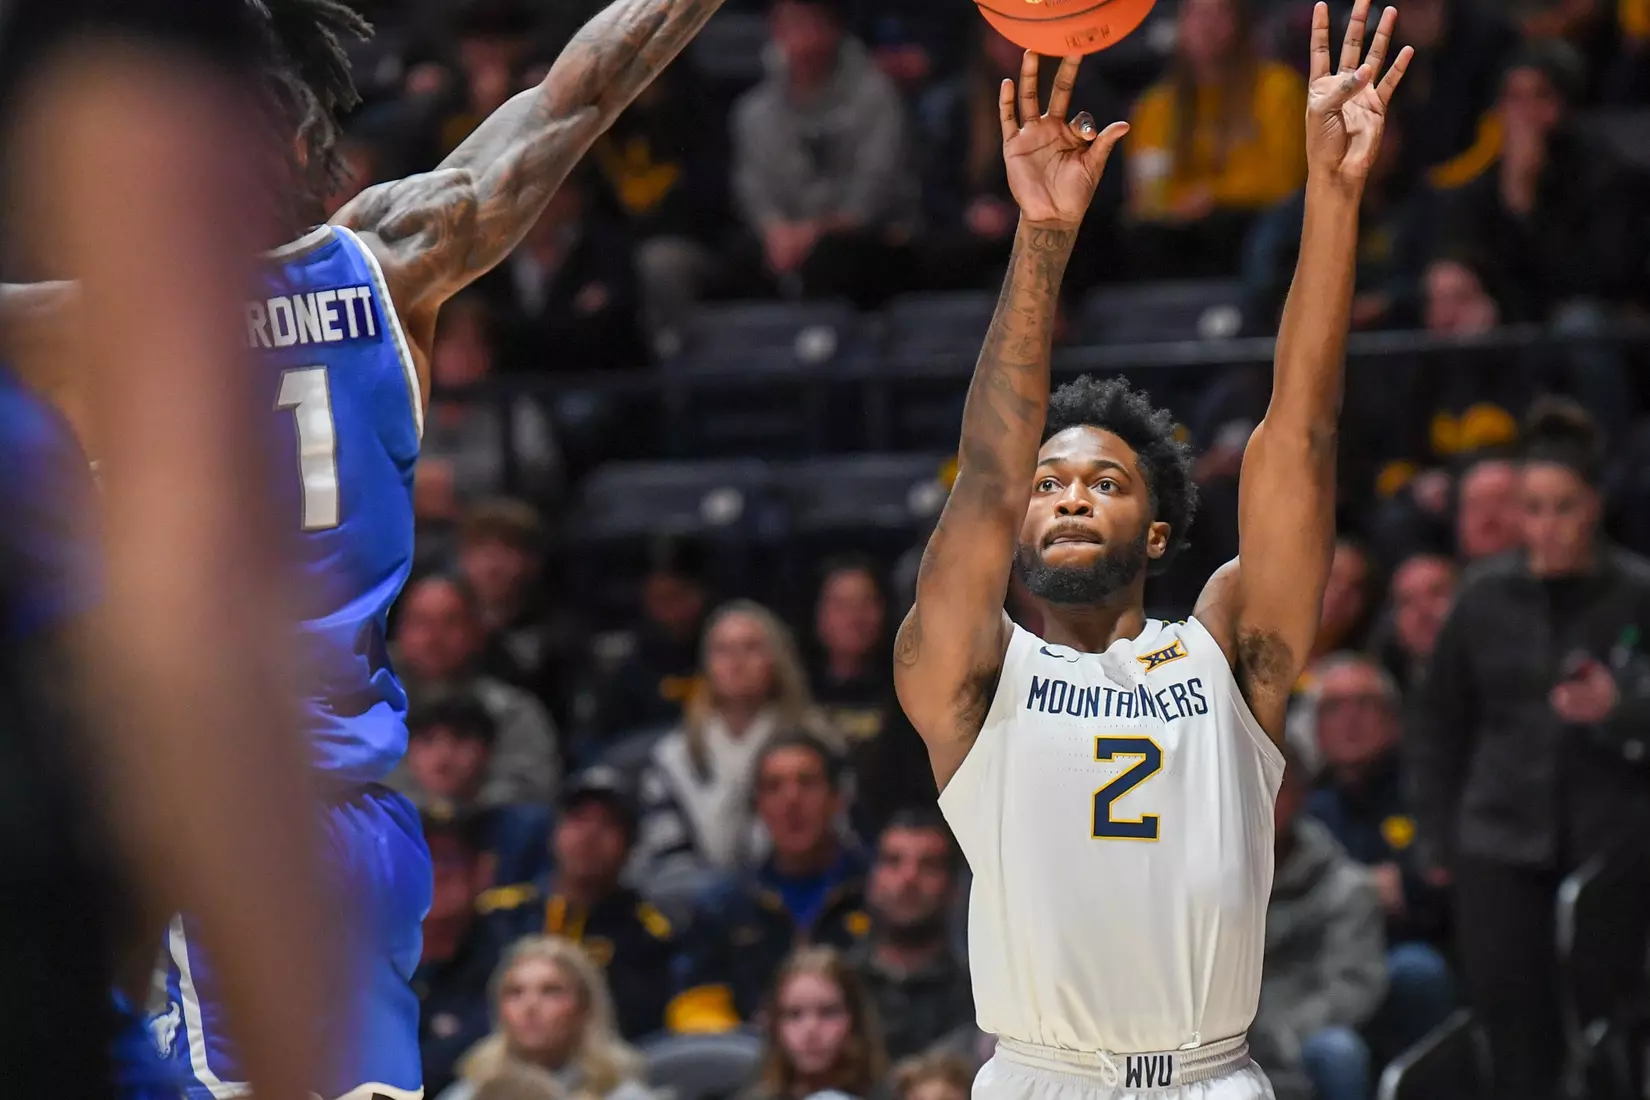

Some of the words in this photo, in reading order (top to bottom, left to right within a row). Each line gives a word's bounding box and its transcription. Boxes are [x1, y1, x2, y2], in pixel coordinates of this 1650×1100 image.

[244, 286, 376, 348] RDNETT
[273, 365, 340, 530] 1
[1140, 641, 1186, 671] XII
[1091, 735, 1164, 841] 2
[1125, 1054, 1173, 1088] WVU
